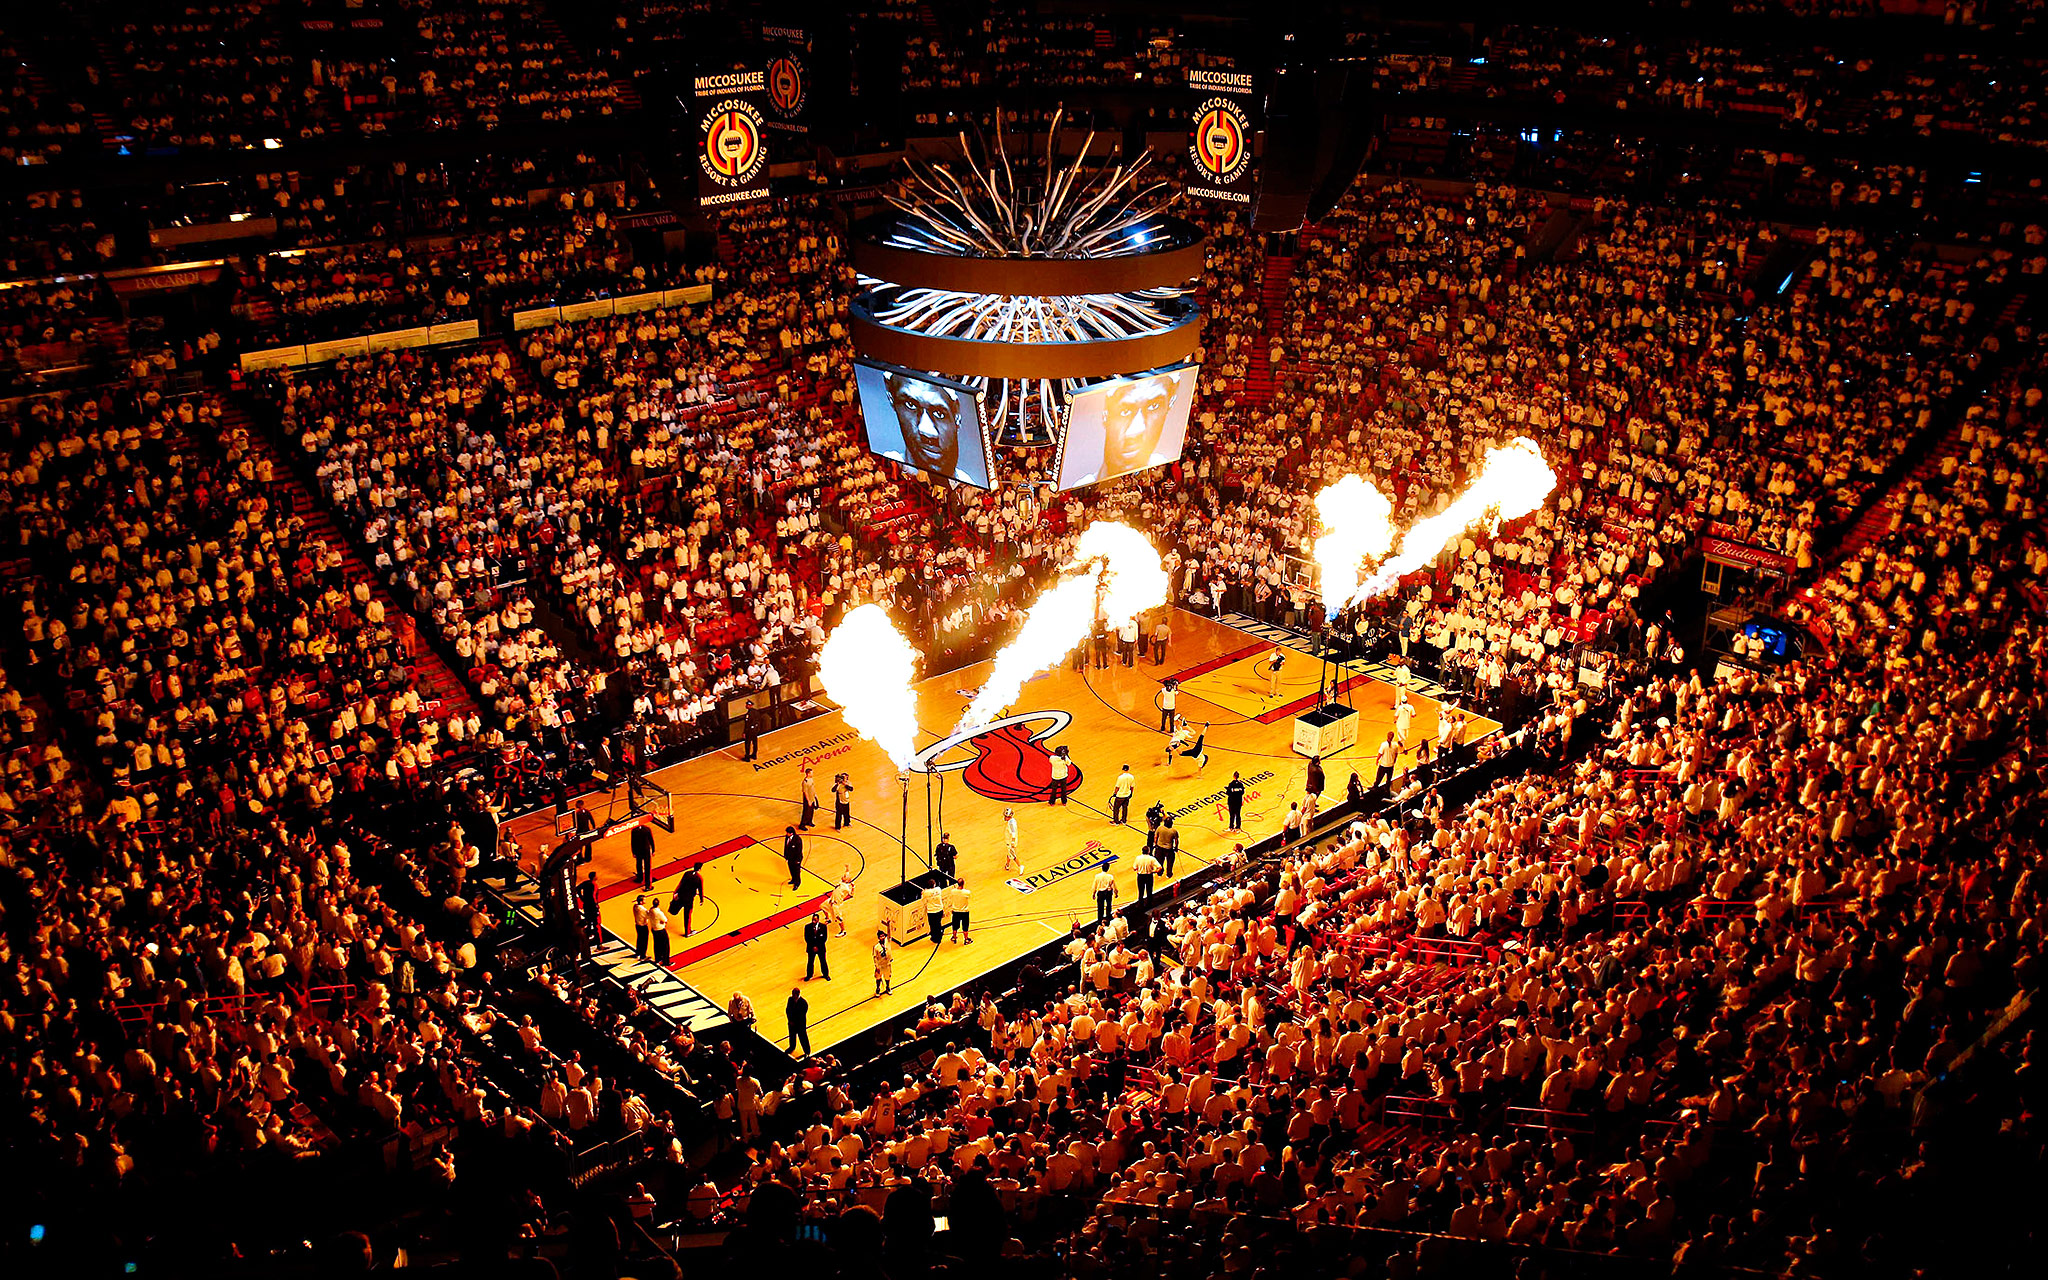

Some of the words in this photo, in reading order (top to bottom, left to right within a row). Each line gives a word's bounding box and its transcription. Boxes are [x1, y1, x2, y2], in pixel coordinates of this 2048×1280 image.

[762, 26, 804, 39] MICCOSUKEE
[695, 71, 764, 89] MICCOSUKEE
[744, 84, 765, 92] FLORIDA
[1189, 70, 1252, 87] MICCOSUKEE
[700, 99, 764, 132] MICCOSUKEE
[1192, 97, 1249, 130] MICCOSUKEE
[699, 153, 729, 186] RESORT
[730, 178, 738, 187] &
[740, 146, 767, 184] GAMING
[1189, 145, 1214, 181] RESORT
[1214, 175, 1222, 185] &
[1223, 151, 1251, 184] GAMING
[700, 188, 770, 206] MICCOSUKEE.COM
[1187, 186, 1250, 203] MICCOSUKEE.COM
[135, 271, 200, 290] BACARDI
[1051, 405, 1070, 481] MICCOSUKEE.COM
[752, 729, 861, 772] AmericanAirlin
[797, 744, 852, 773] Arena
[1026, 846, 1112, 888] PLAYOFFS
[590, 940, 731, 1032] MIAMI
